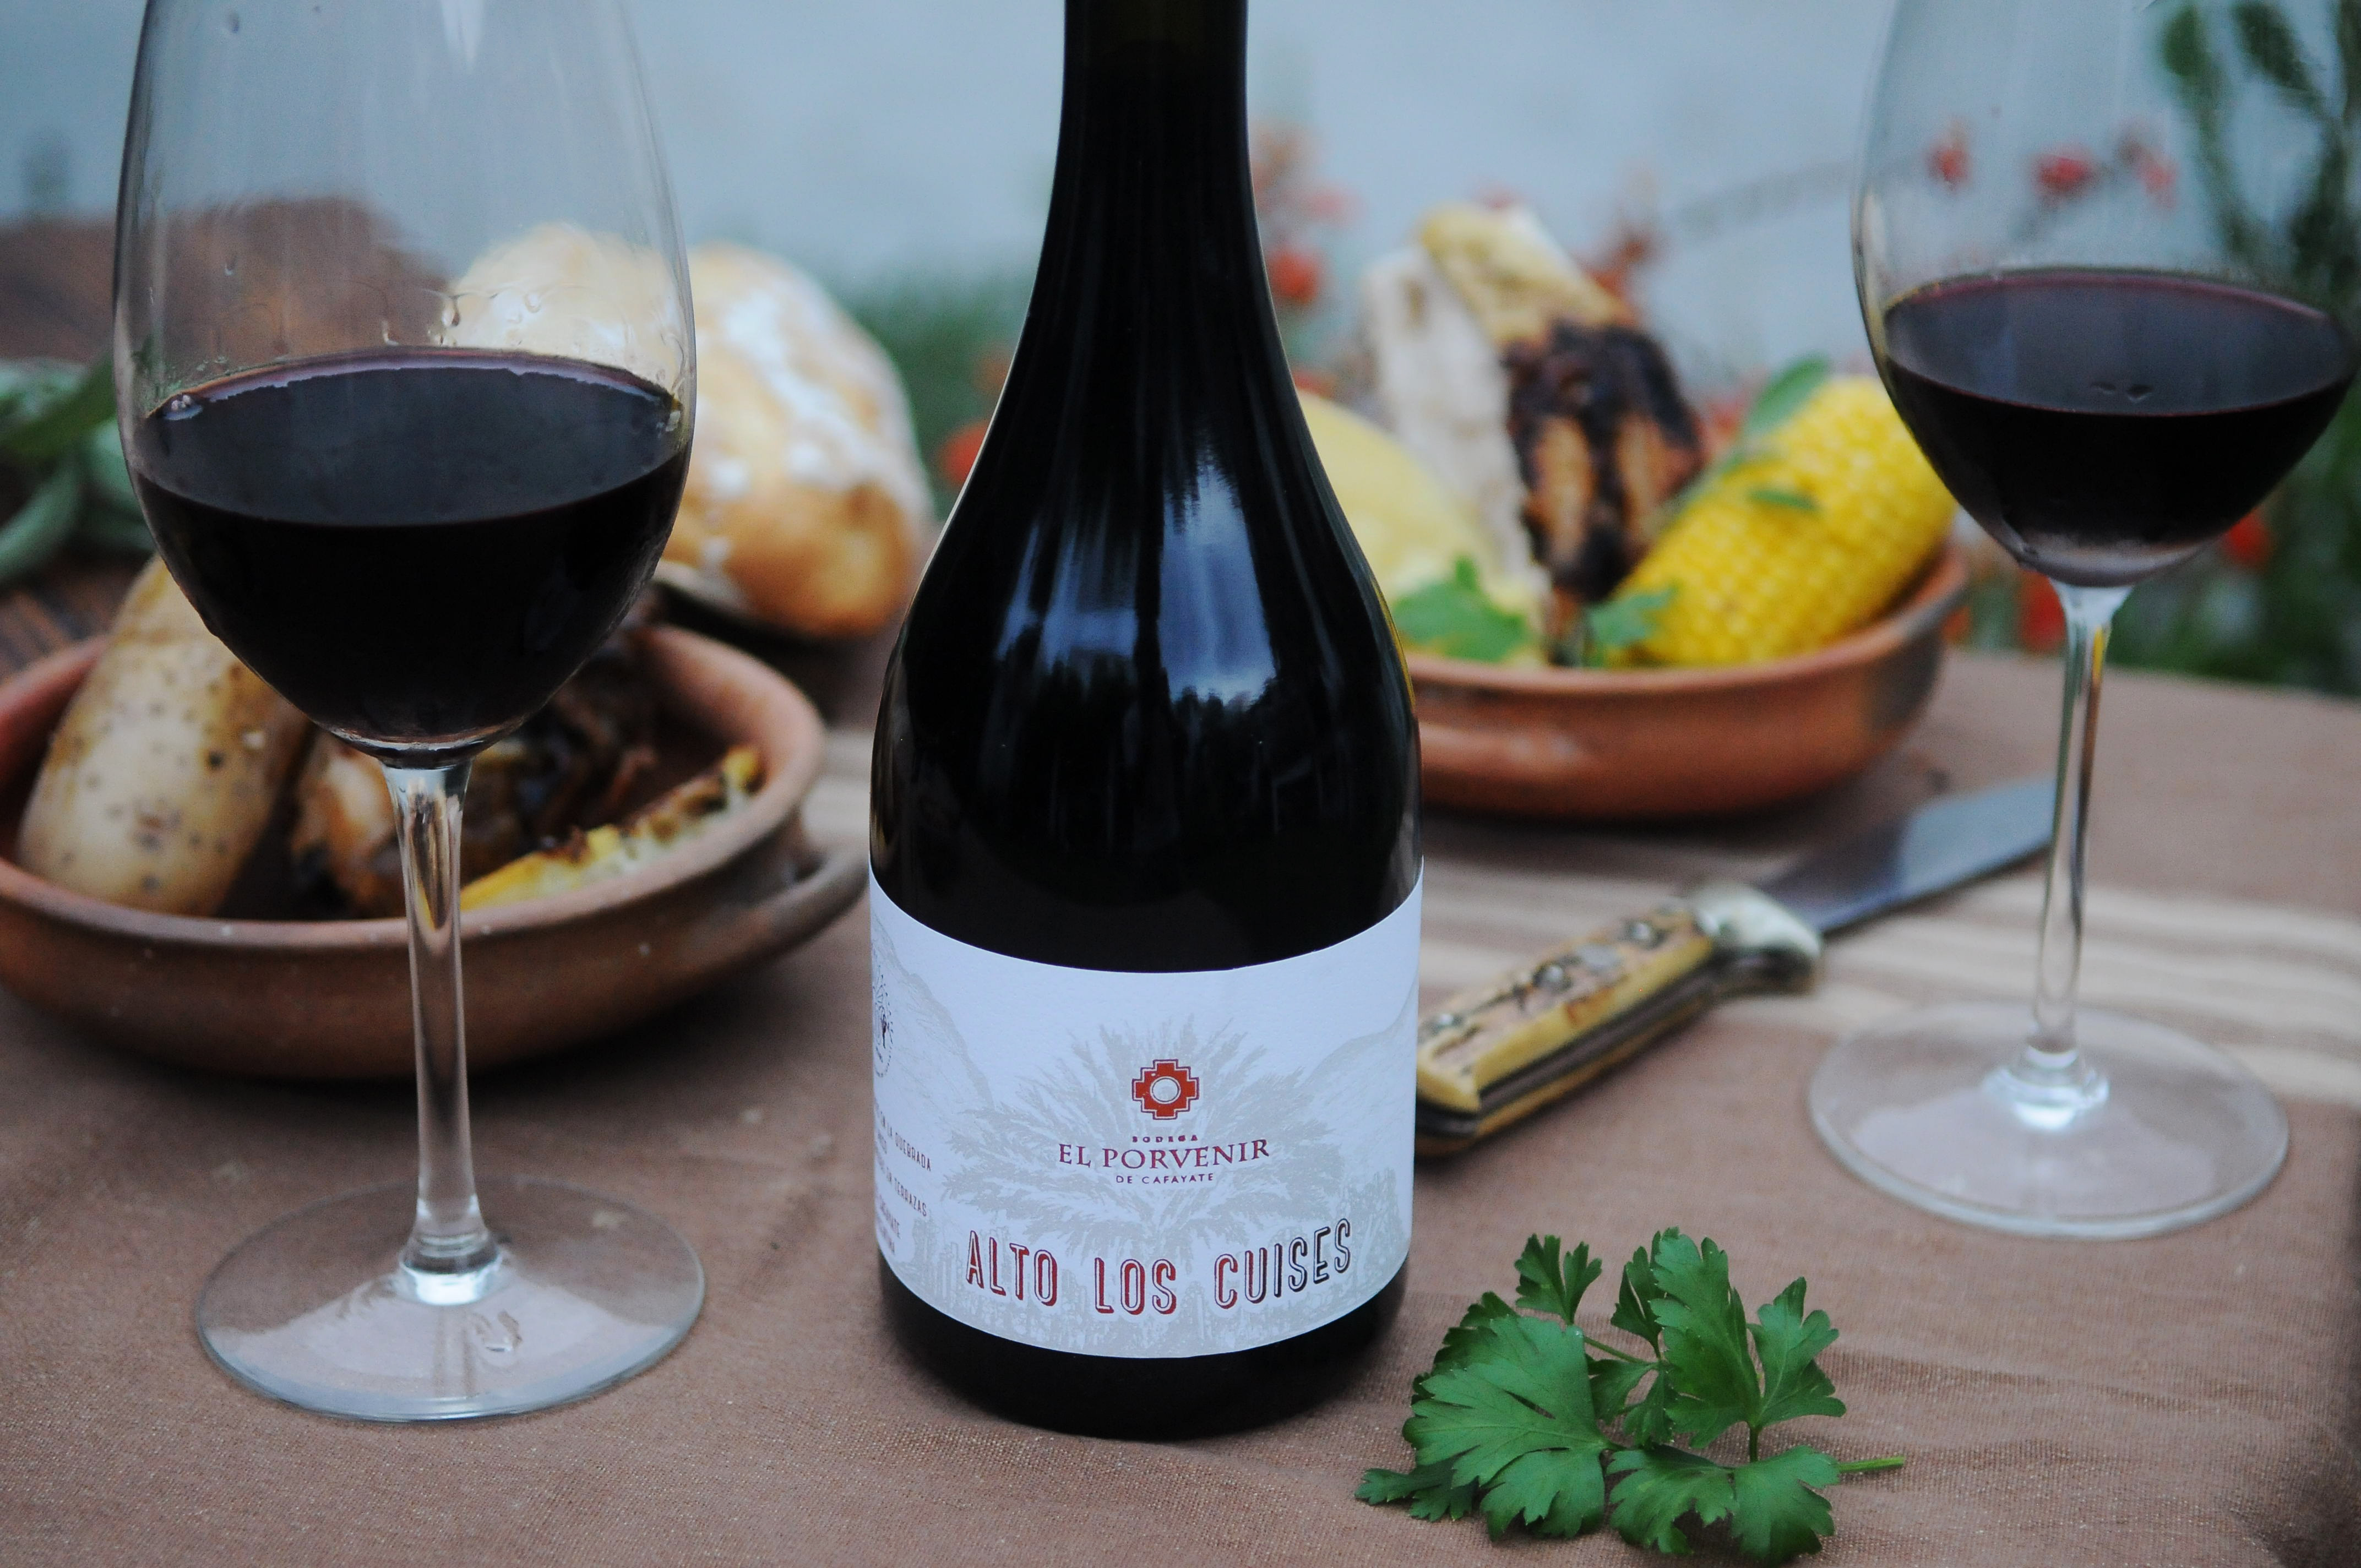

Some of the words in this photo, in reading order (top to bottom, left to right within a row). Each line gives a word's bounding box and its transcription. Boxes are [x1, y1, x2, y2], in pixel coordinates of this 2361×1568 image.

[895, 1132, 931, 1172] QUEBRADA
[1058, 1143, 1091, 1168] EL
[1102, 1139, 1270, 1169] PORVENIR
[1132, 1135, 1199, 1143] BODEGA
[1116, 1174, 1133, 1184] DE
[1141, 1173, 1214, 1184] CAFAYATE
[894, 1177, 927, 1217] TERRAZAS
[966, 1229, 1058, 1306] ALTO
[1094, 1257, 1177, 1315] LOS
[1214, 1218, 1351, 1309] CUISES
